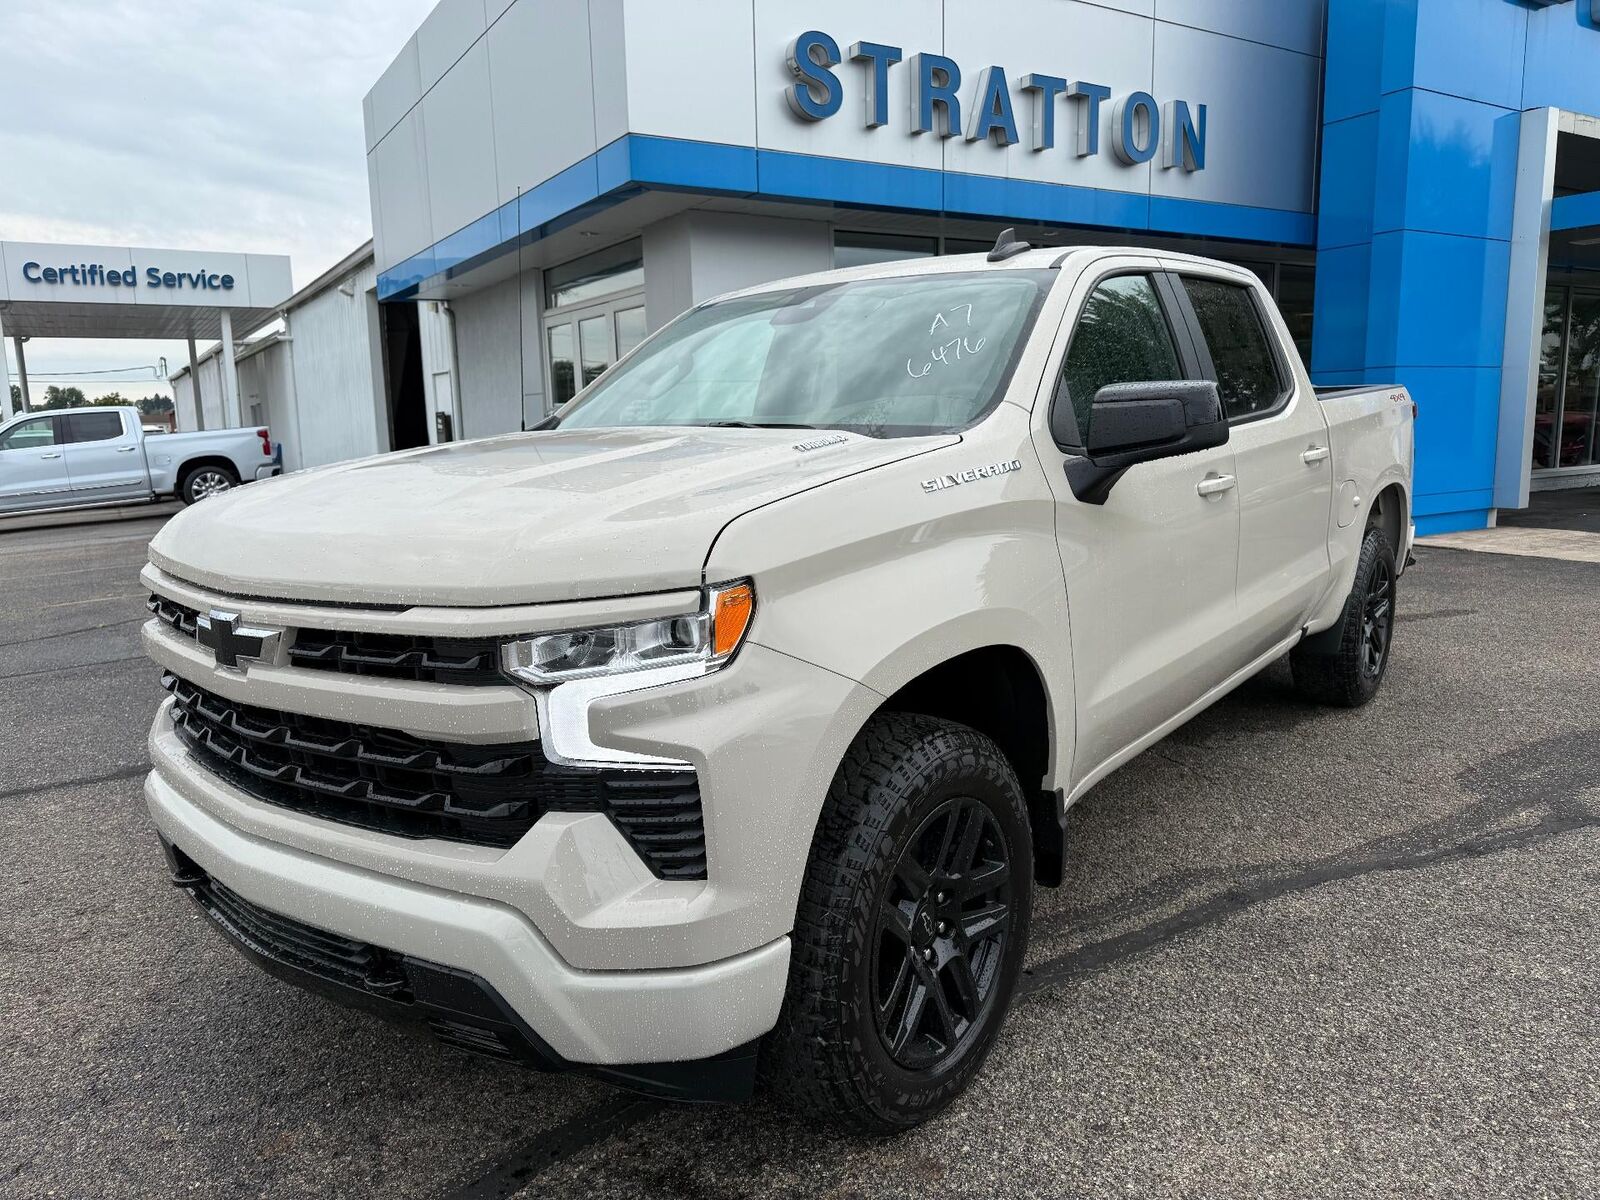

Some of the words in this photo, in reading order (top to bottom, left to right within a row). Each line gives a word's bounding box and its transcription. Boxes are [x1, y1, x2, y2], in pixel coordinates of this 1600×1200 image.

[784, 30, 1207, 172] STRATTON
[22, 261, 138, 287] Certified
[146, 266, 235, 290] Service
[906, 336, 986, 378] 6476
[920, 459, 1022, 493] SILVERADO
